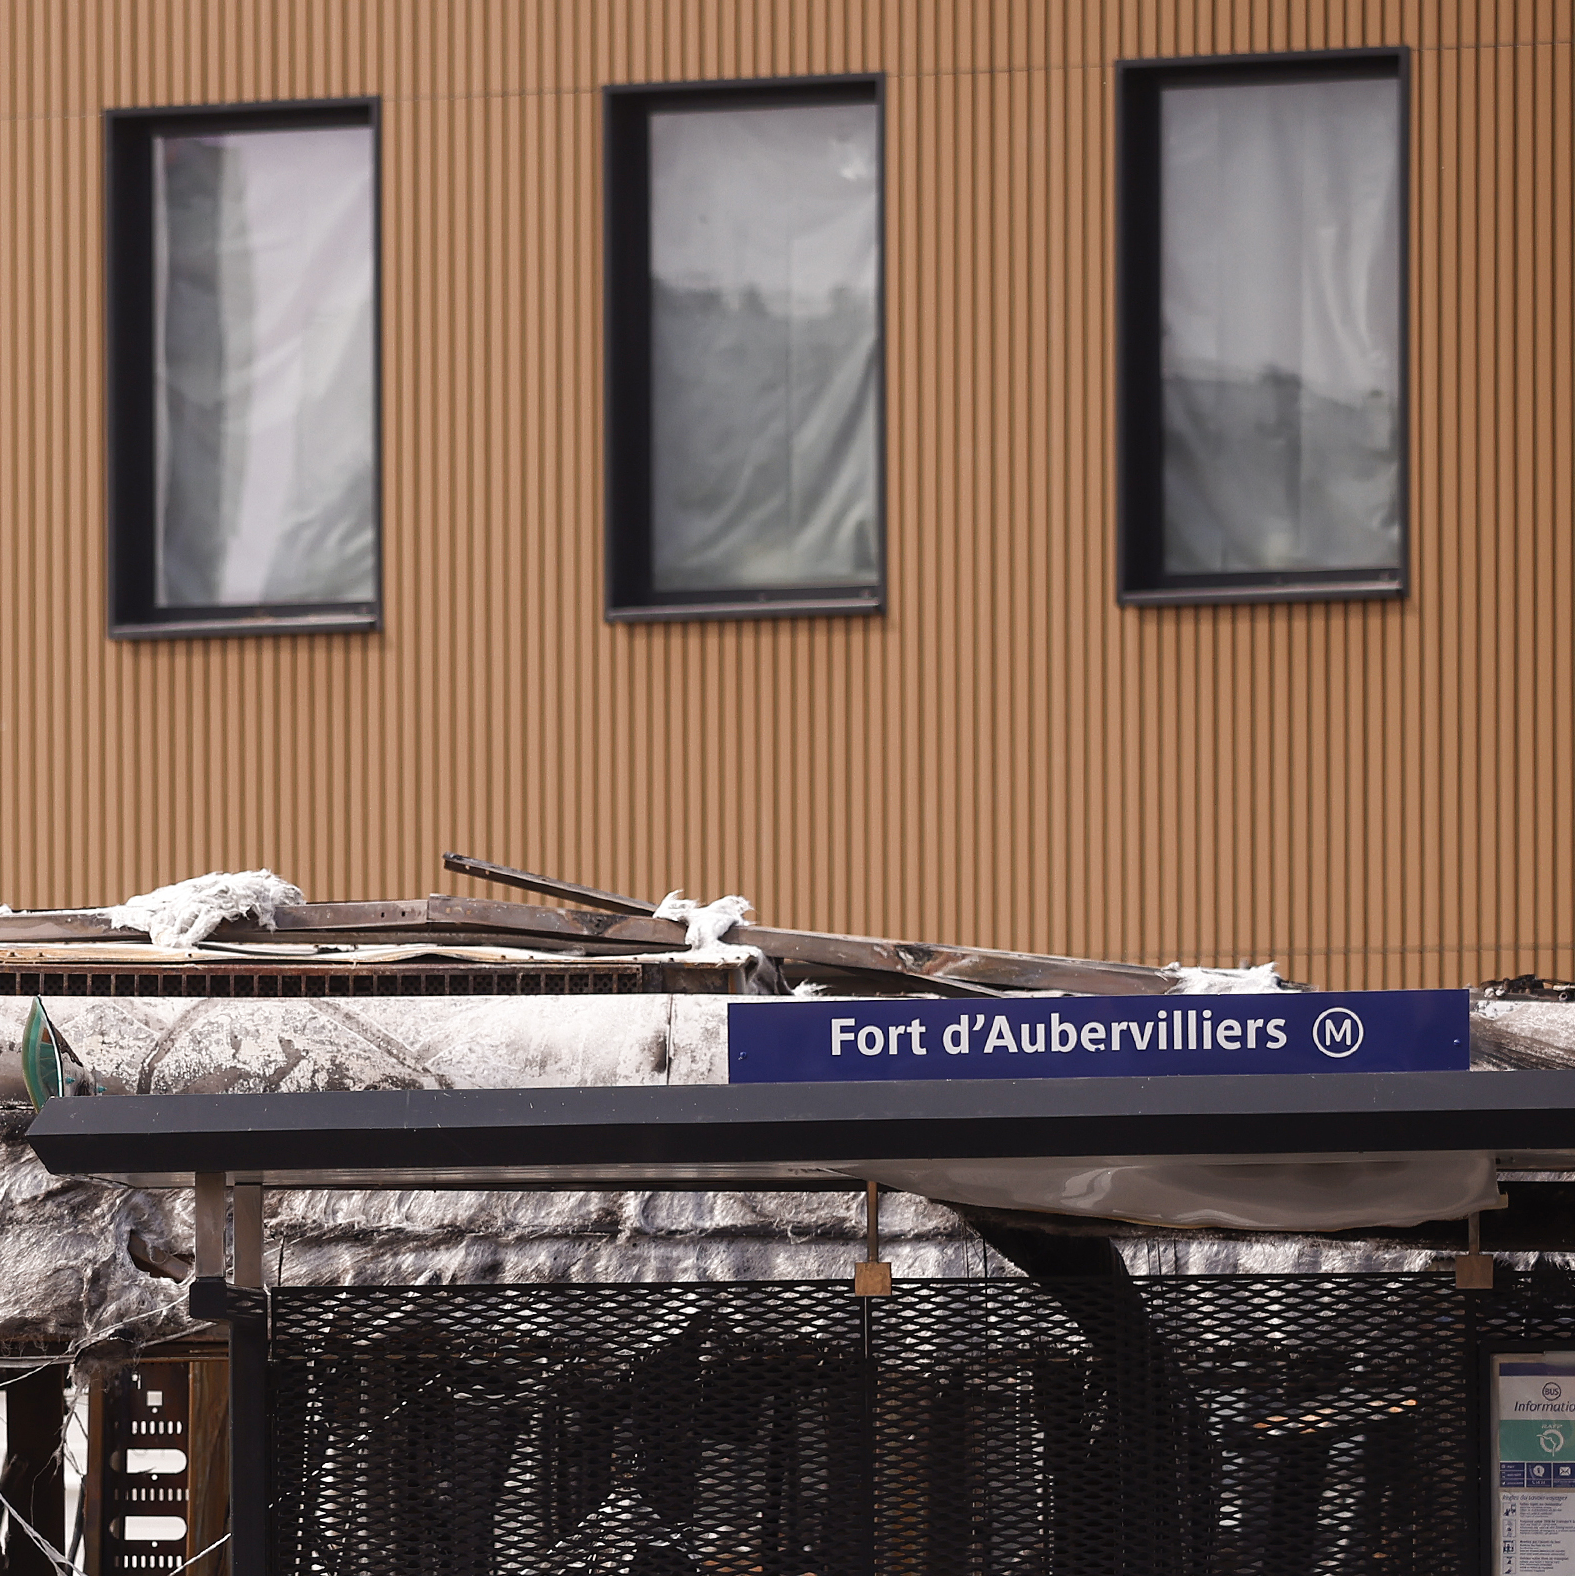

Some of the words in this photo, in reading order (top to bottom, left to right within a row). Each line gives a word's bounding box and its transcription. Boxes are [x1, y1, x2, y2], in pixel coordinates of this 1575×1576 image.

[830, 1018, 927, 1056] Fort
[942, 1009, 1287, 1055] d'Aubervilliers
[1544, 1388, 1560, 1396] BUS
